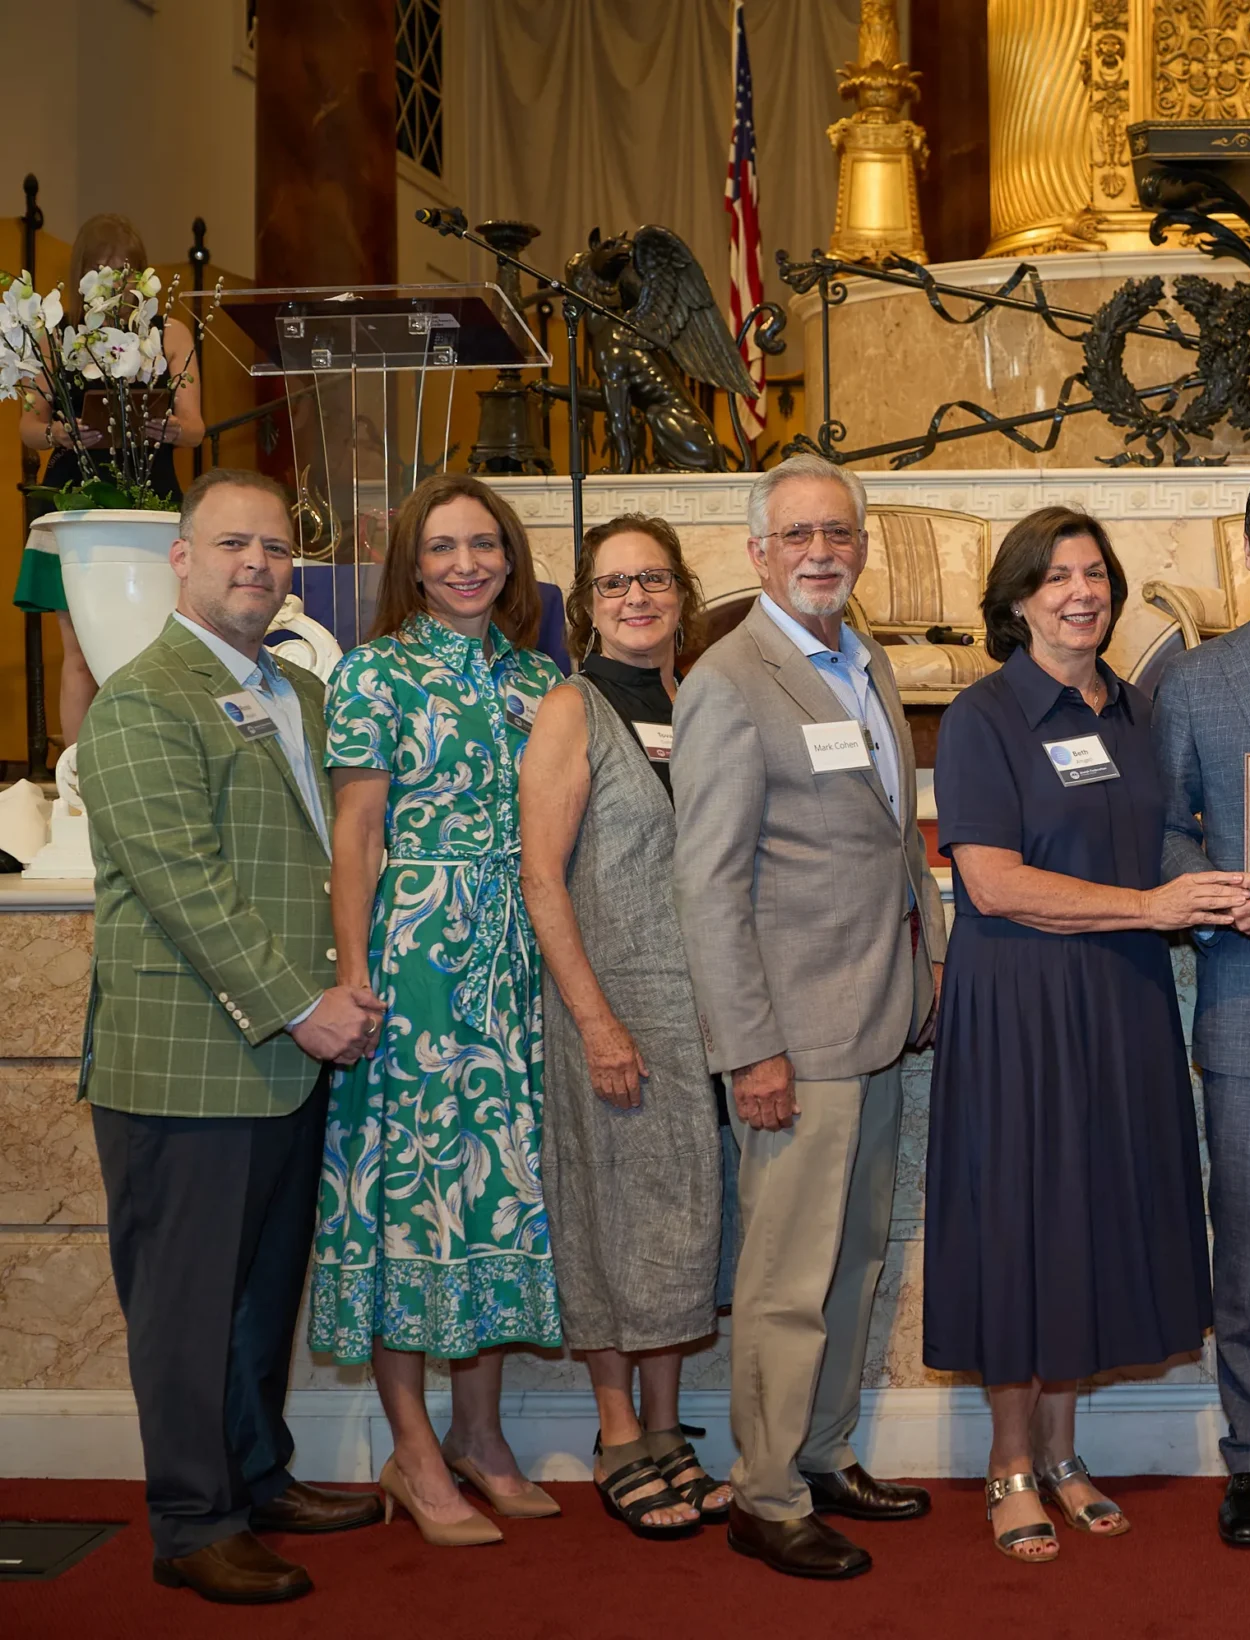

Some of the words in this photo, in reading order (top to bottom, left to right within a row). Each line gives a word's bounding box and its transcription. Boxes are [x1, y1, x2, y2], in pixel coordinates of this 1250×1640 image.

[813, 743, 833, 752] Mark
[834, 740, 859, 750] Cohen
[1072, 749, 1089, 757] Beth
